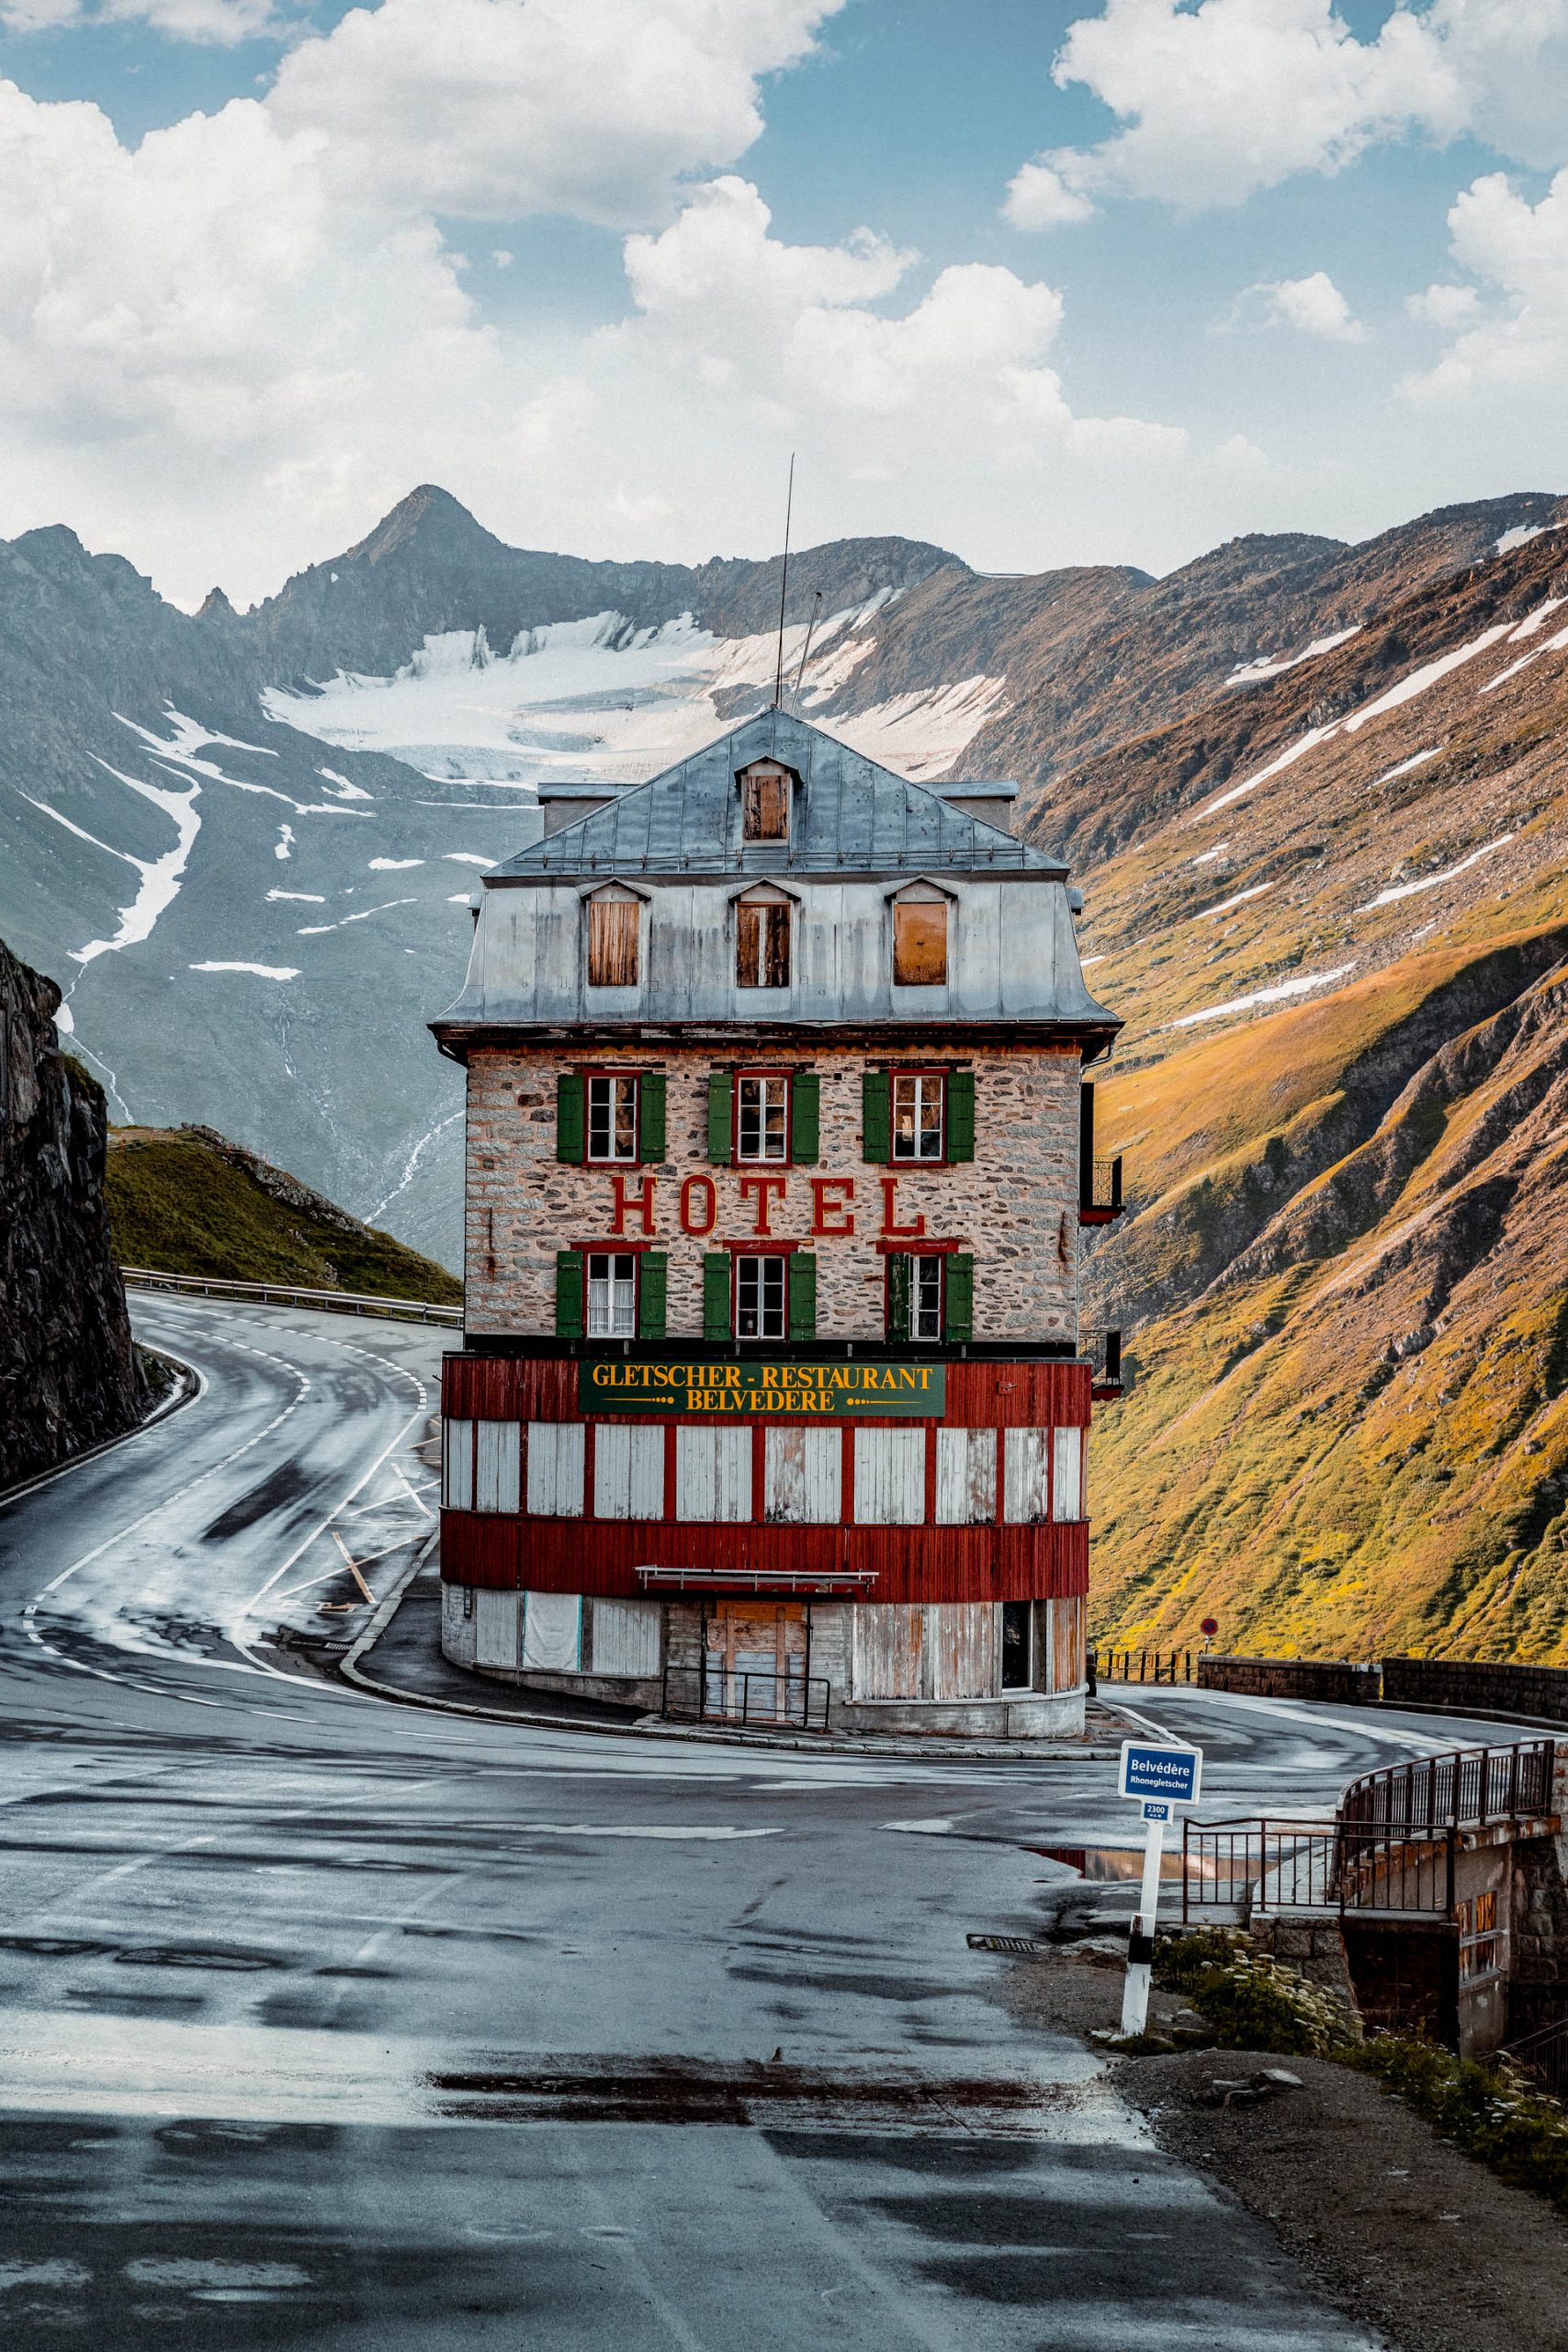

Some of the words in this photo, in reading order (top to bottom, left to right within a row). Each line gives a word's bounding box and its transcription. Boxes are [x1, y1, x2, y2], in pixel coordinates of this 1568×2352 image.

[610, 1174, 925, 1236] HOTEL
[592, 1364, 742, 1387] GLETSCHER
[761, 1366, 933, 1389] RESTAURANT
[685, 1389, 835, 1411] BELVEDERE
[1131, 1759, 1190, 1776] Belvédère
[1131, 1776, 1189, 1789] Rhonegletscher
[1147, 1805, 1165, 1814] 2300
